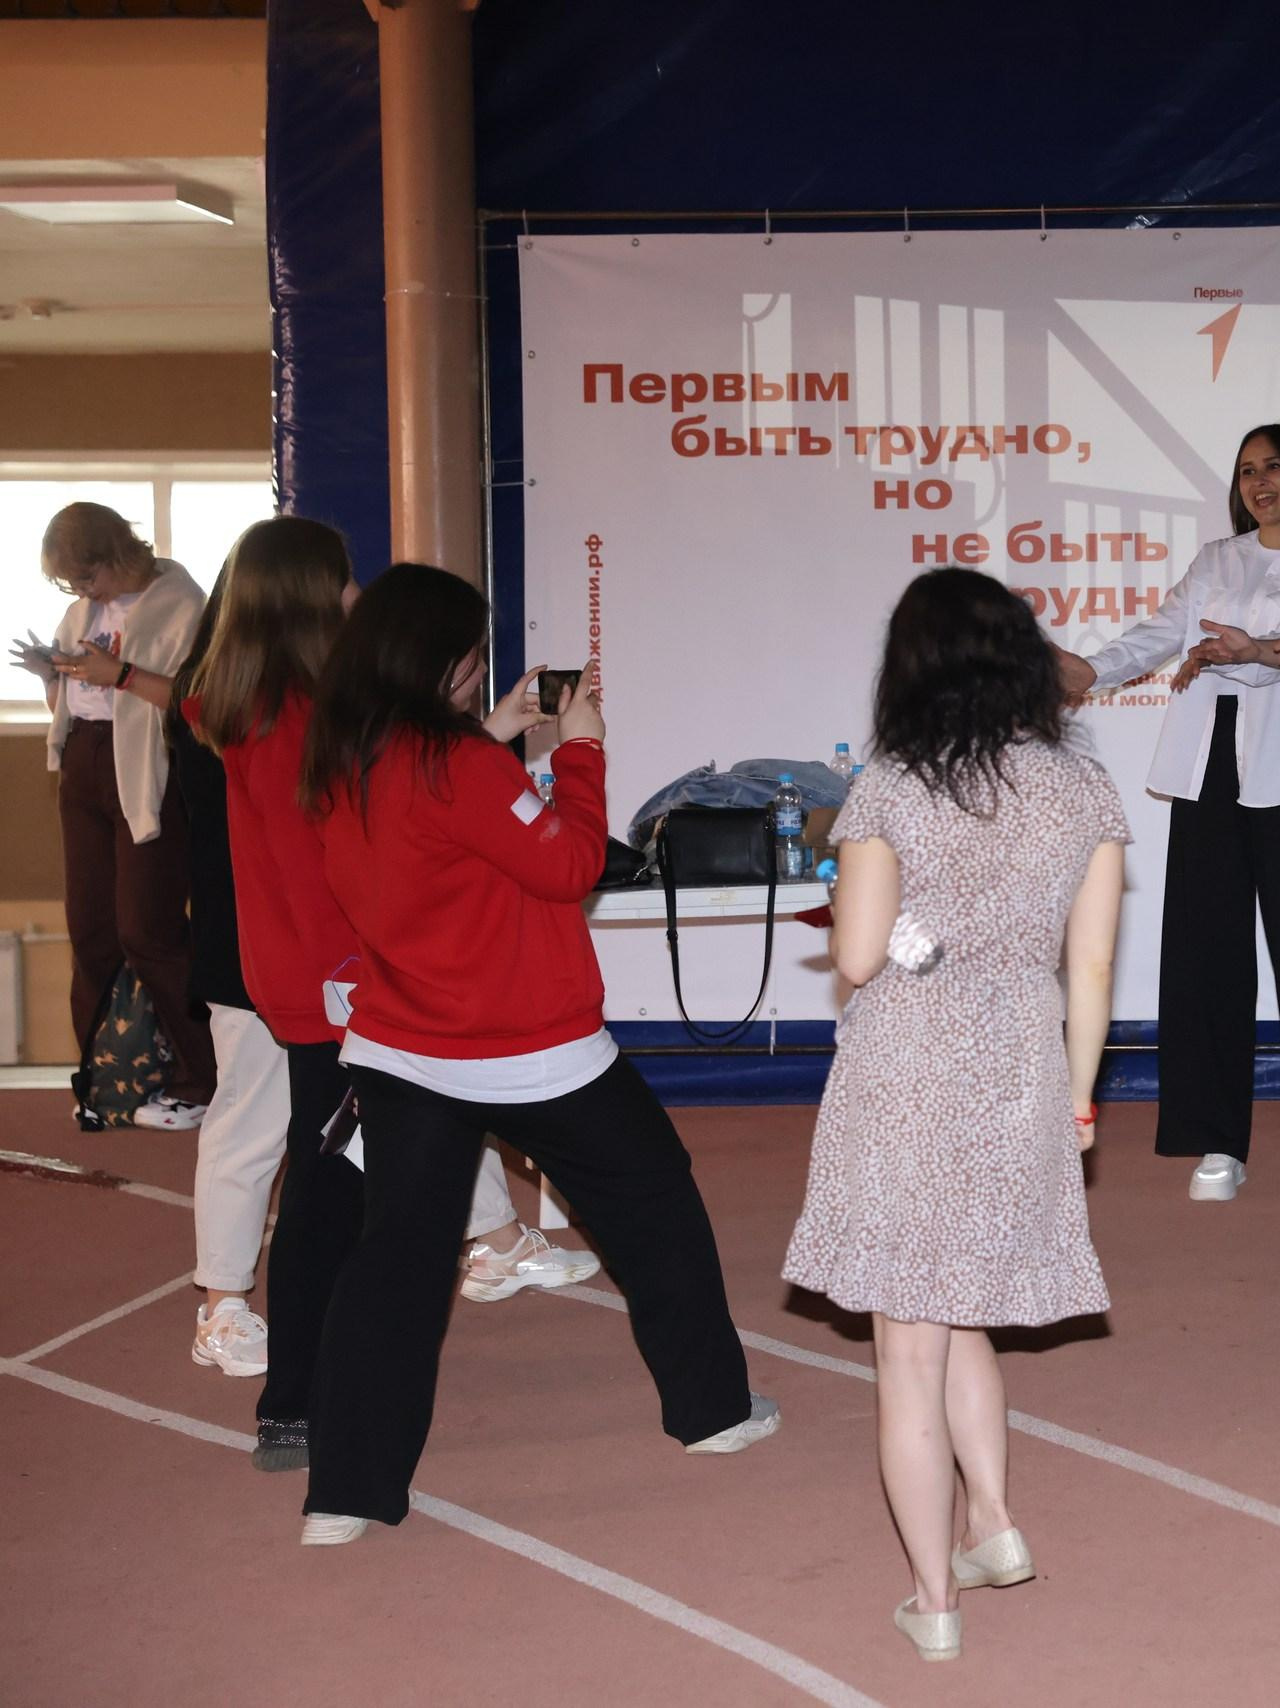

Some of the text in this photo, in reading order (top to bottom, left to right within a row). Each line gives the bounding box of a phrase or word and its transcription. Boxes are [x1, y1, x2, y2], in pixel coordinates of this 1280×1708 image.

[1194, 287, 1243, 301] Первые
[582, 363, 850, 413] Первым
[671, 414, 1092, 465] быть трудно,
[873, 480, 953, 510] но
[911, 520, 1169, 564] не быть
[1009, 586, 1174, 627] рудн
